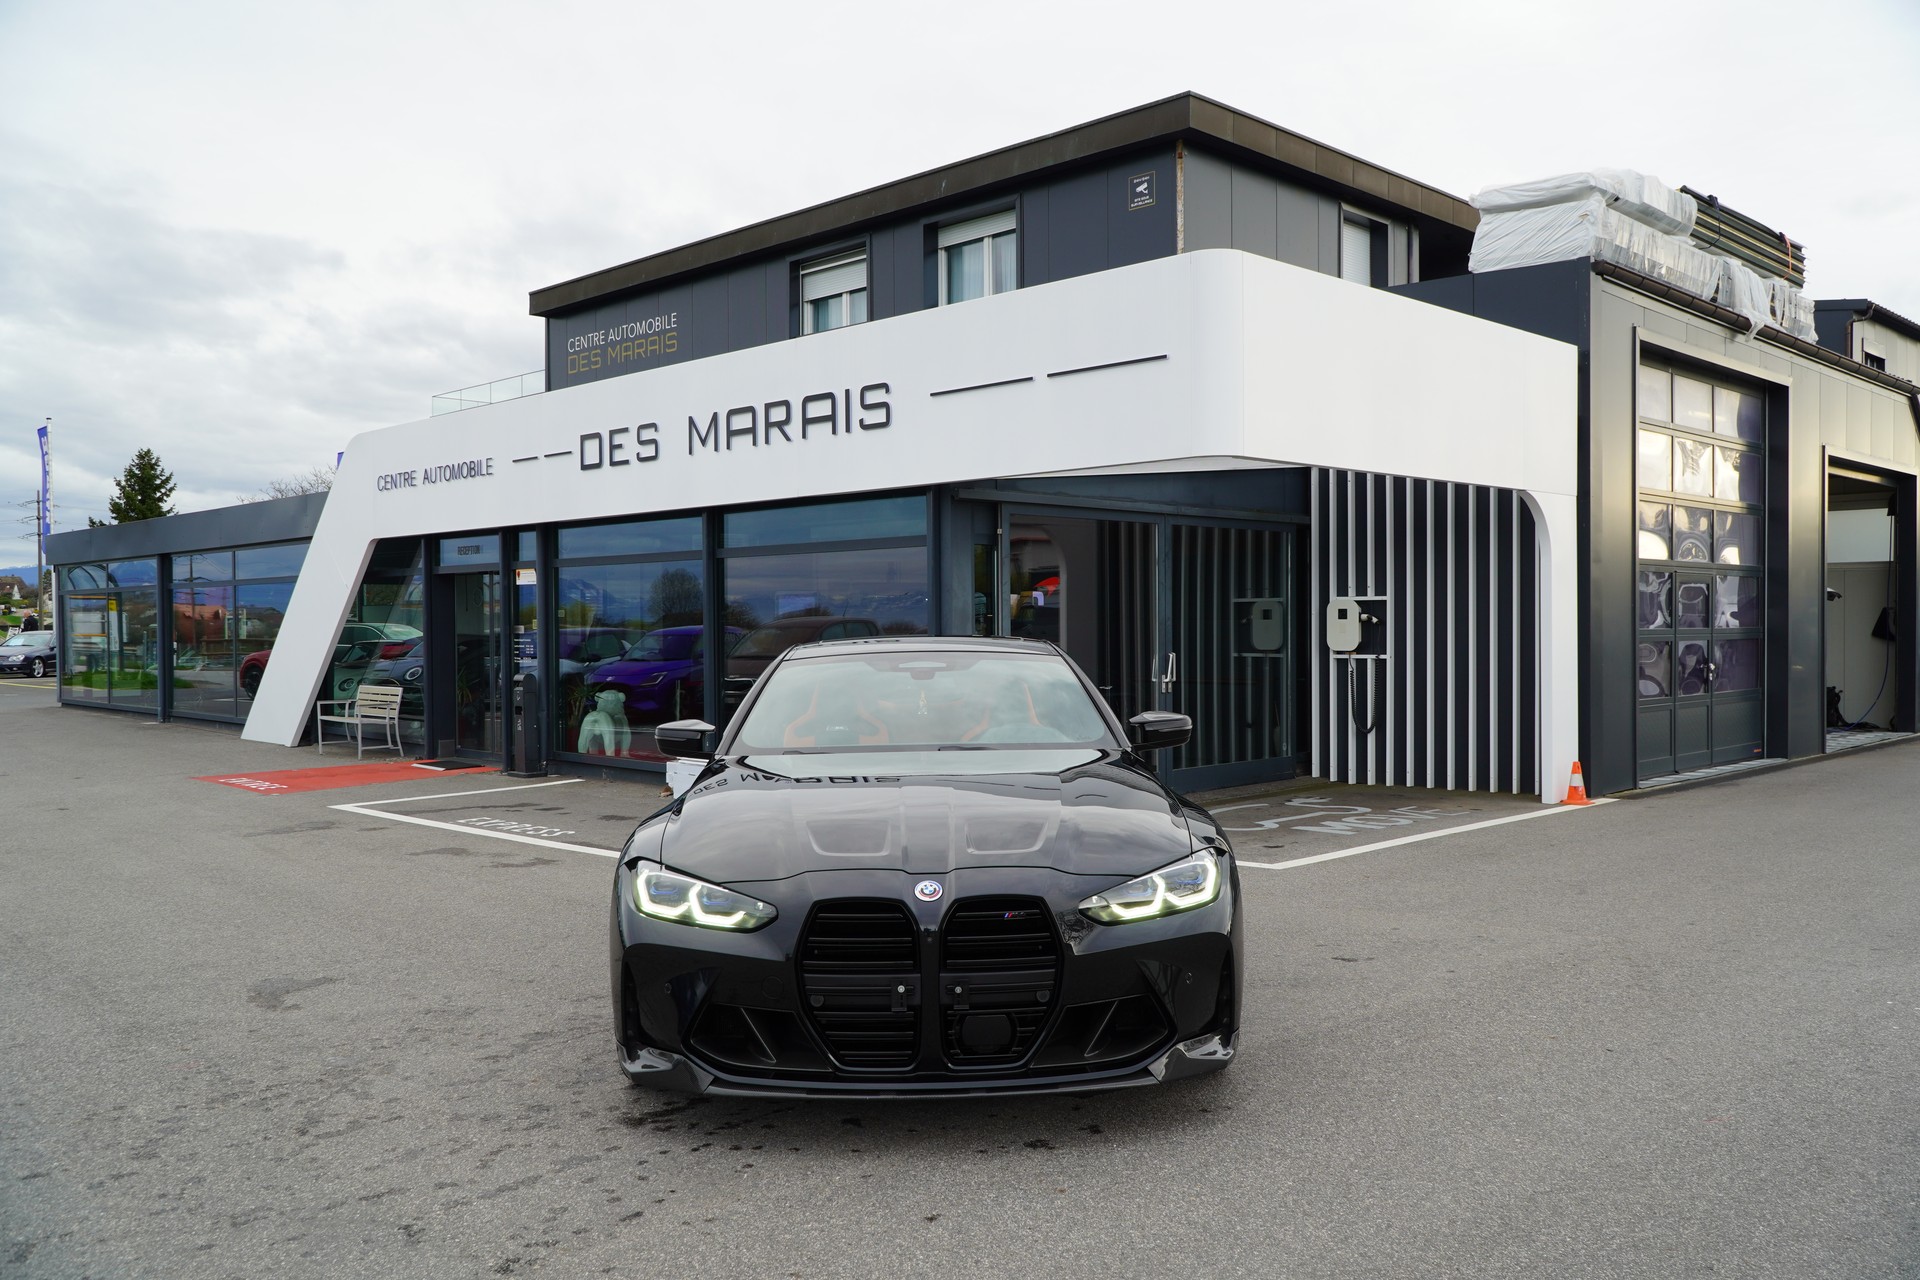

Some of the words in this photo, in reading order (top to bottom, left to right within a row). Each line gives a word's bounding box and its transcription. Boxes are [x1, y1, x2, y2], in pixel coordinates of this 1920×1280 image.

[568, 330, 605, 352] CENTRE
[608, 312, 677, 342] AUTOMOBILE
[567, 349, 602, 375] DES
[608, 332, 677, 364] MARAIS
[376, 469, 418, 492] CENTRE
[422, 456, 494, 485] AUTOMOBILE
[579, 422, 660, 471] DES
[687, 382, 893, 456] MARAIS
[1290, 805, 1471, 835] MOVE
